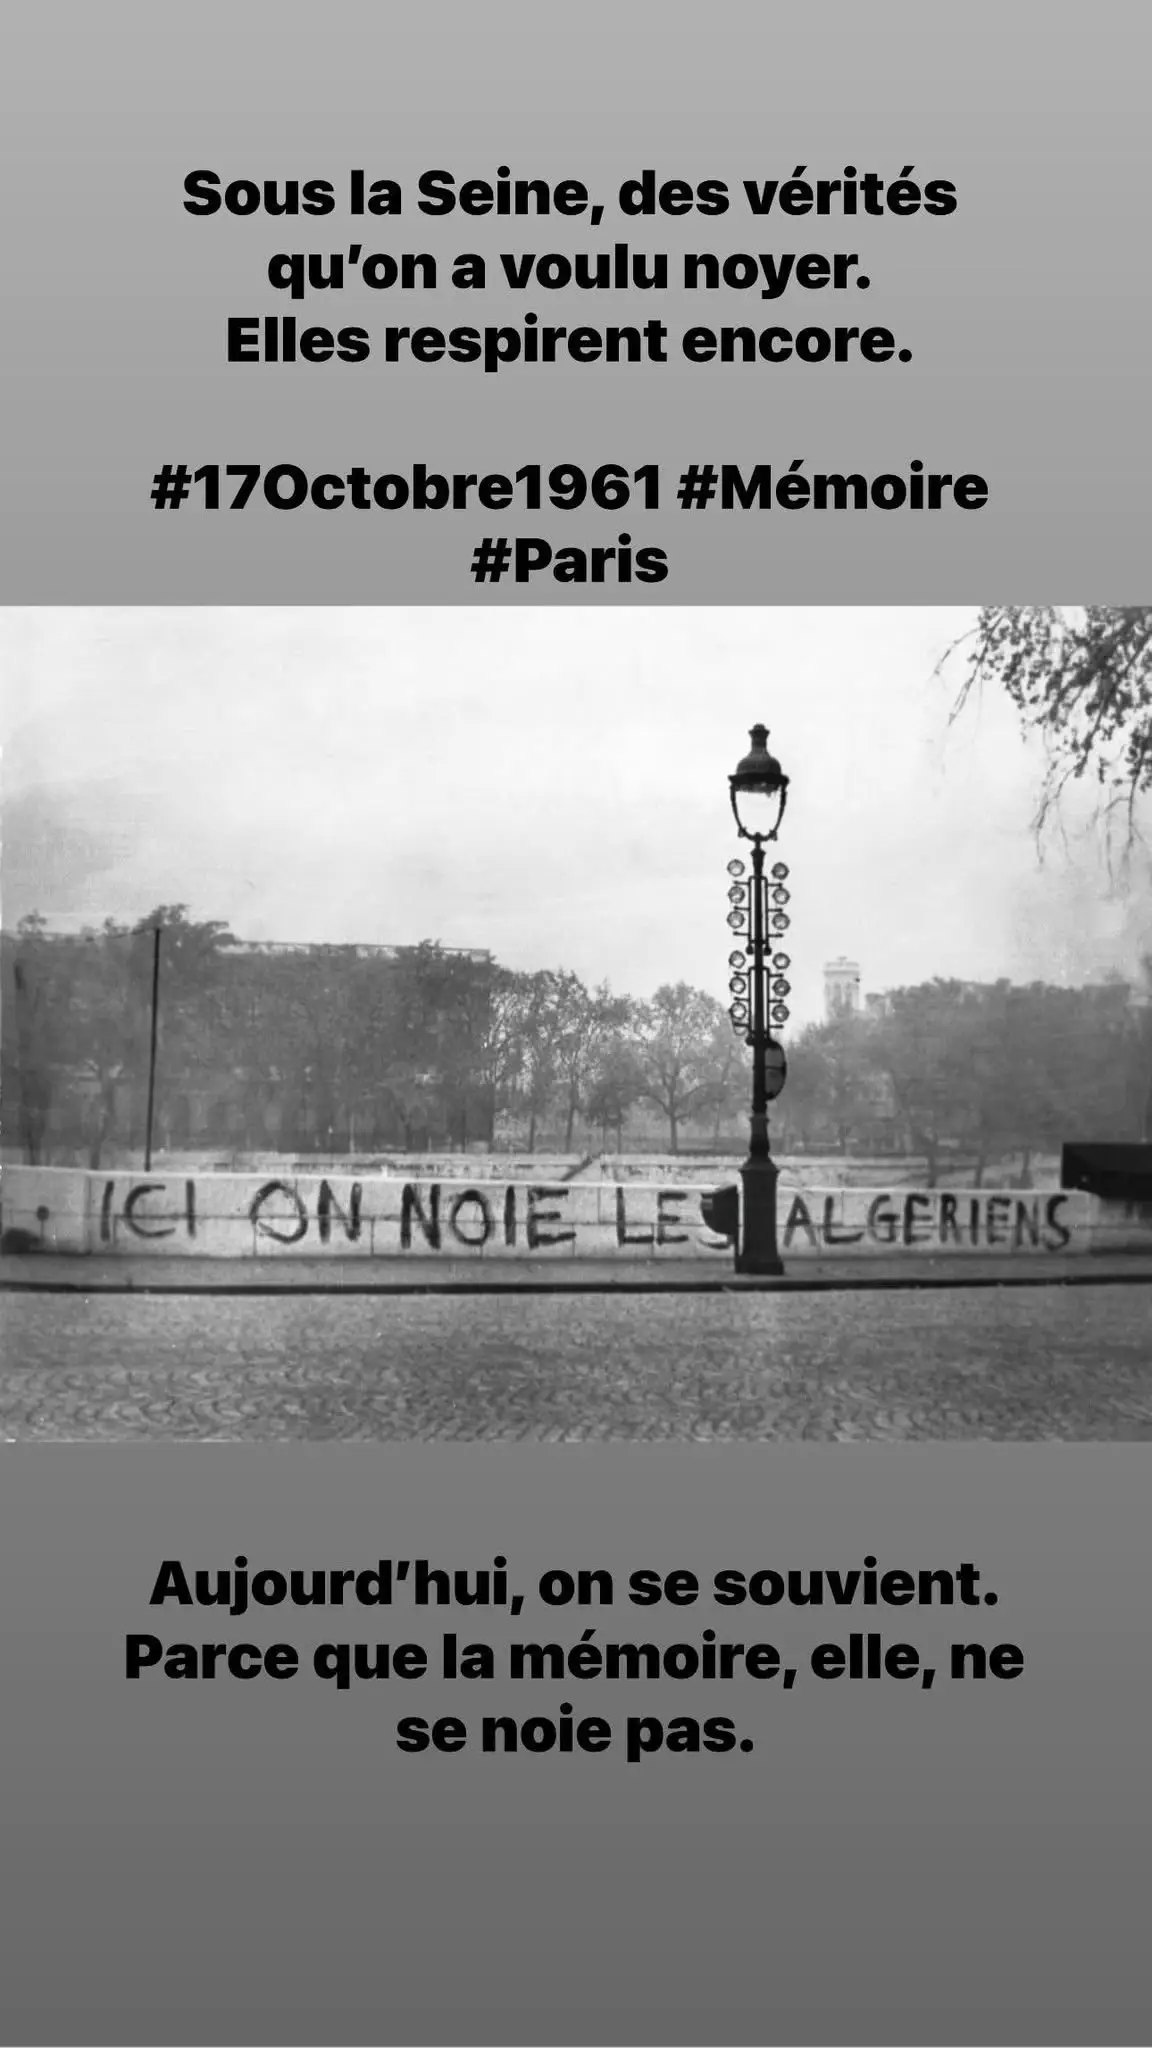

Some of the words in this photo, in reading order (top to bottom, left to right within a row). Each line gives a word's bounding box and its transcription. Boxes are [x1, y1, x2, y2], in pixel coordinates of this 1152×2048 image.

[100, 1180, 195, 1240] ICI
[250, 1180, 361, 1244] ON
[401, 1183, 576, 1248] NOIE
[783, 1194, 1071, 1252] ALGERIENS
